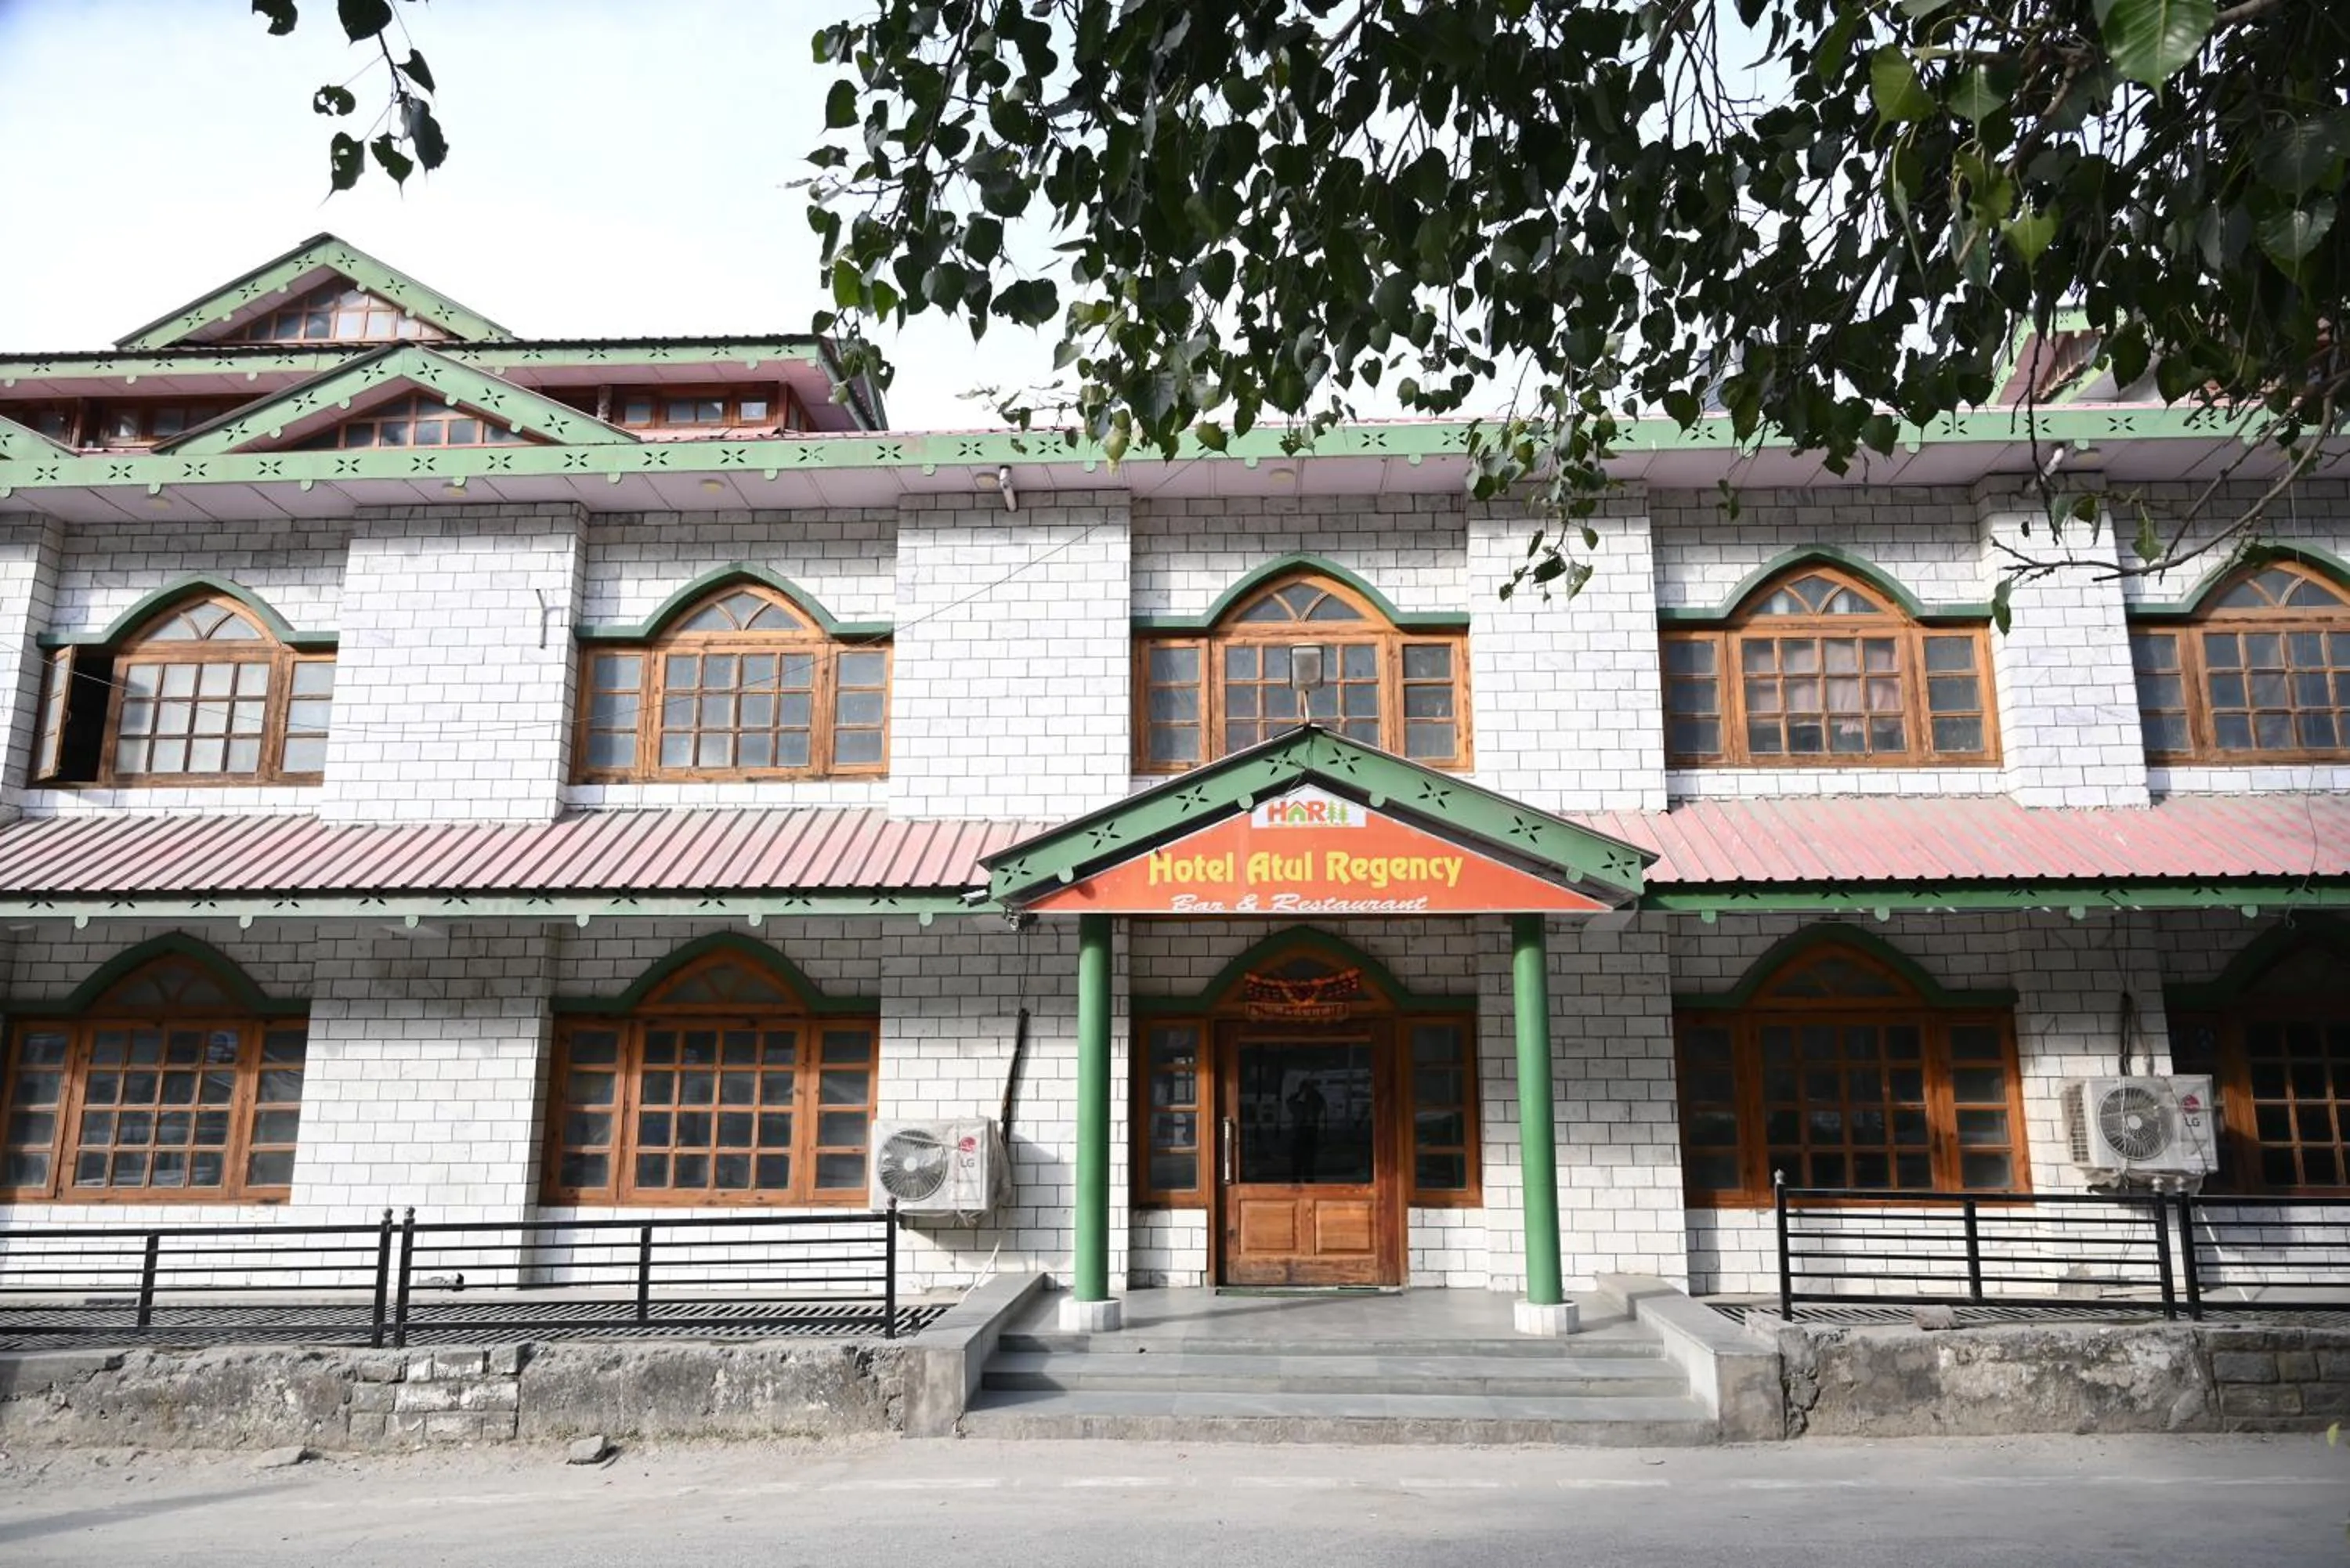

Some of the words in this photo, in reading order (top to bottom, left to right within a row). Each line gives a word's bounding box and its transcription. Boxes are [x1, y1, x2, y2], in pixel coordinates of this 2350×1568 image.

[1148, 851, 1234, 887] Hotel
[1247, 851, 1313, 886] Atul
[1326, 851, 1463, 889] Regency
[1171, 893, 1224, 912] Bar
[1235, 893, 1258, 912] &
[1271, 893, 1428, 912] Restaurant
[2185, 1117, 2200, 1127] LG
[960, 1158, 975, 1168] LG
